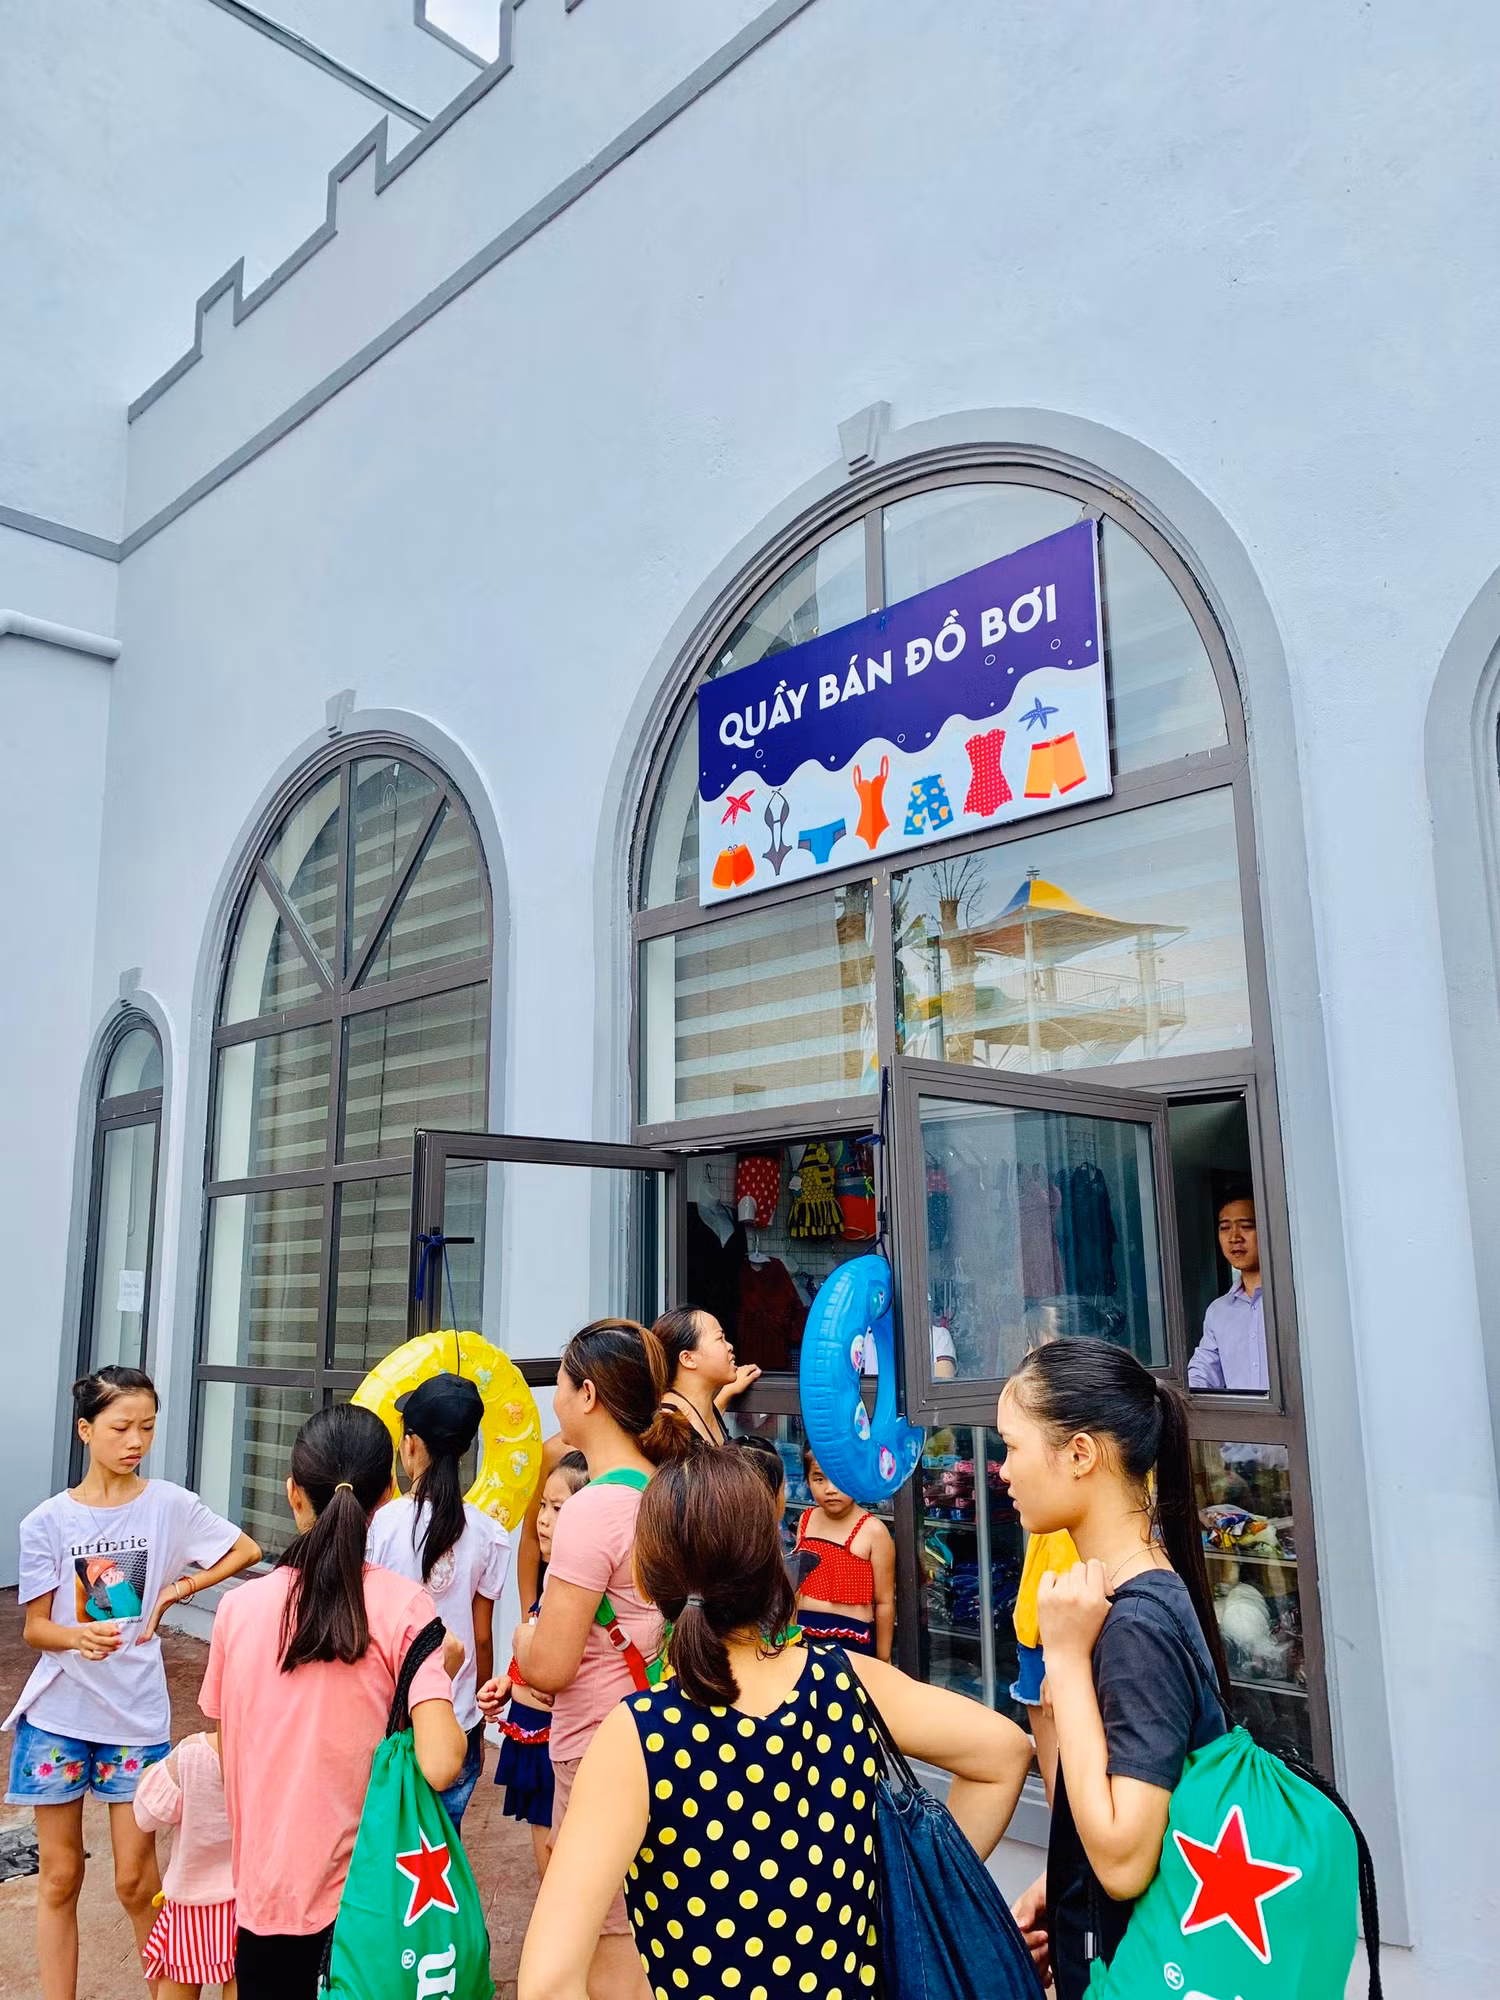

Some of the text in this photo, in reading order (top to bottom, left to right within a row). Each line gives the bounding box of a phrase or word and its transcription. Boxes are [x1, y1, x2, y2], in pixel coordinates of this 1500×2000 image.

[718, 583, 1057, 749] QUẦY BÁN ĐỒ BƠI
